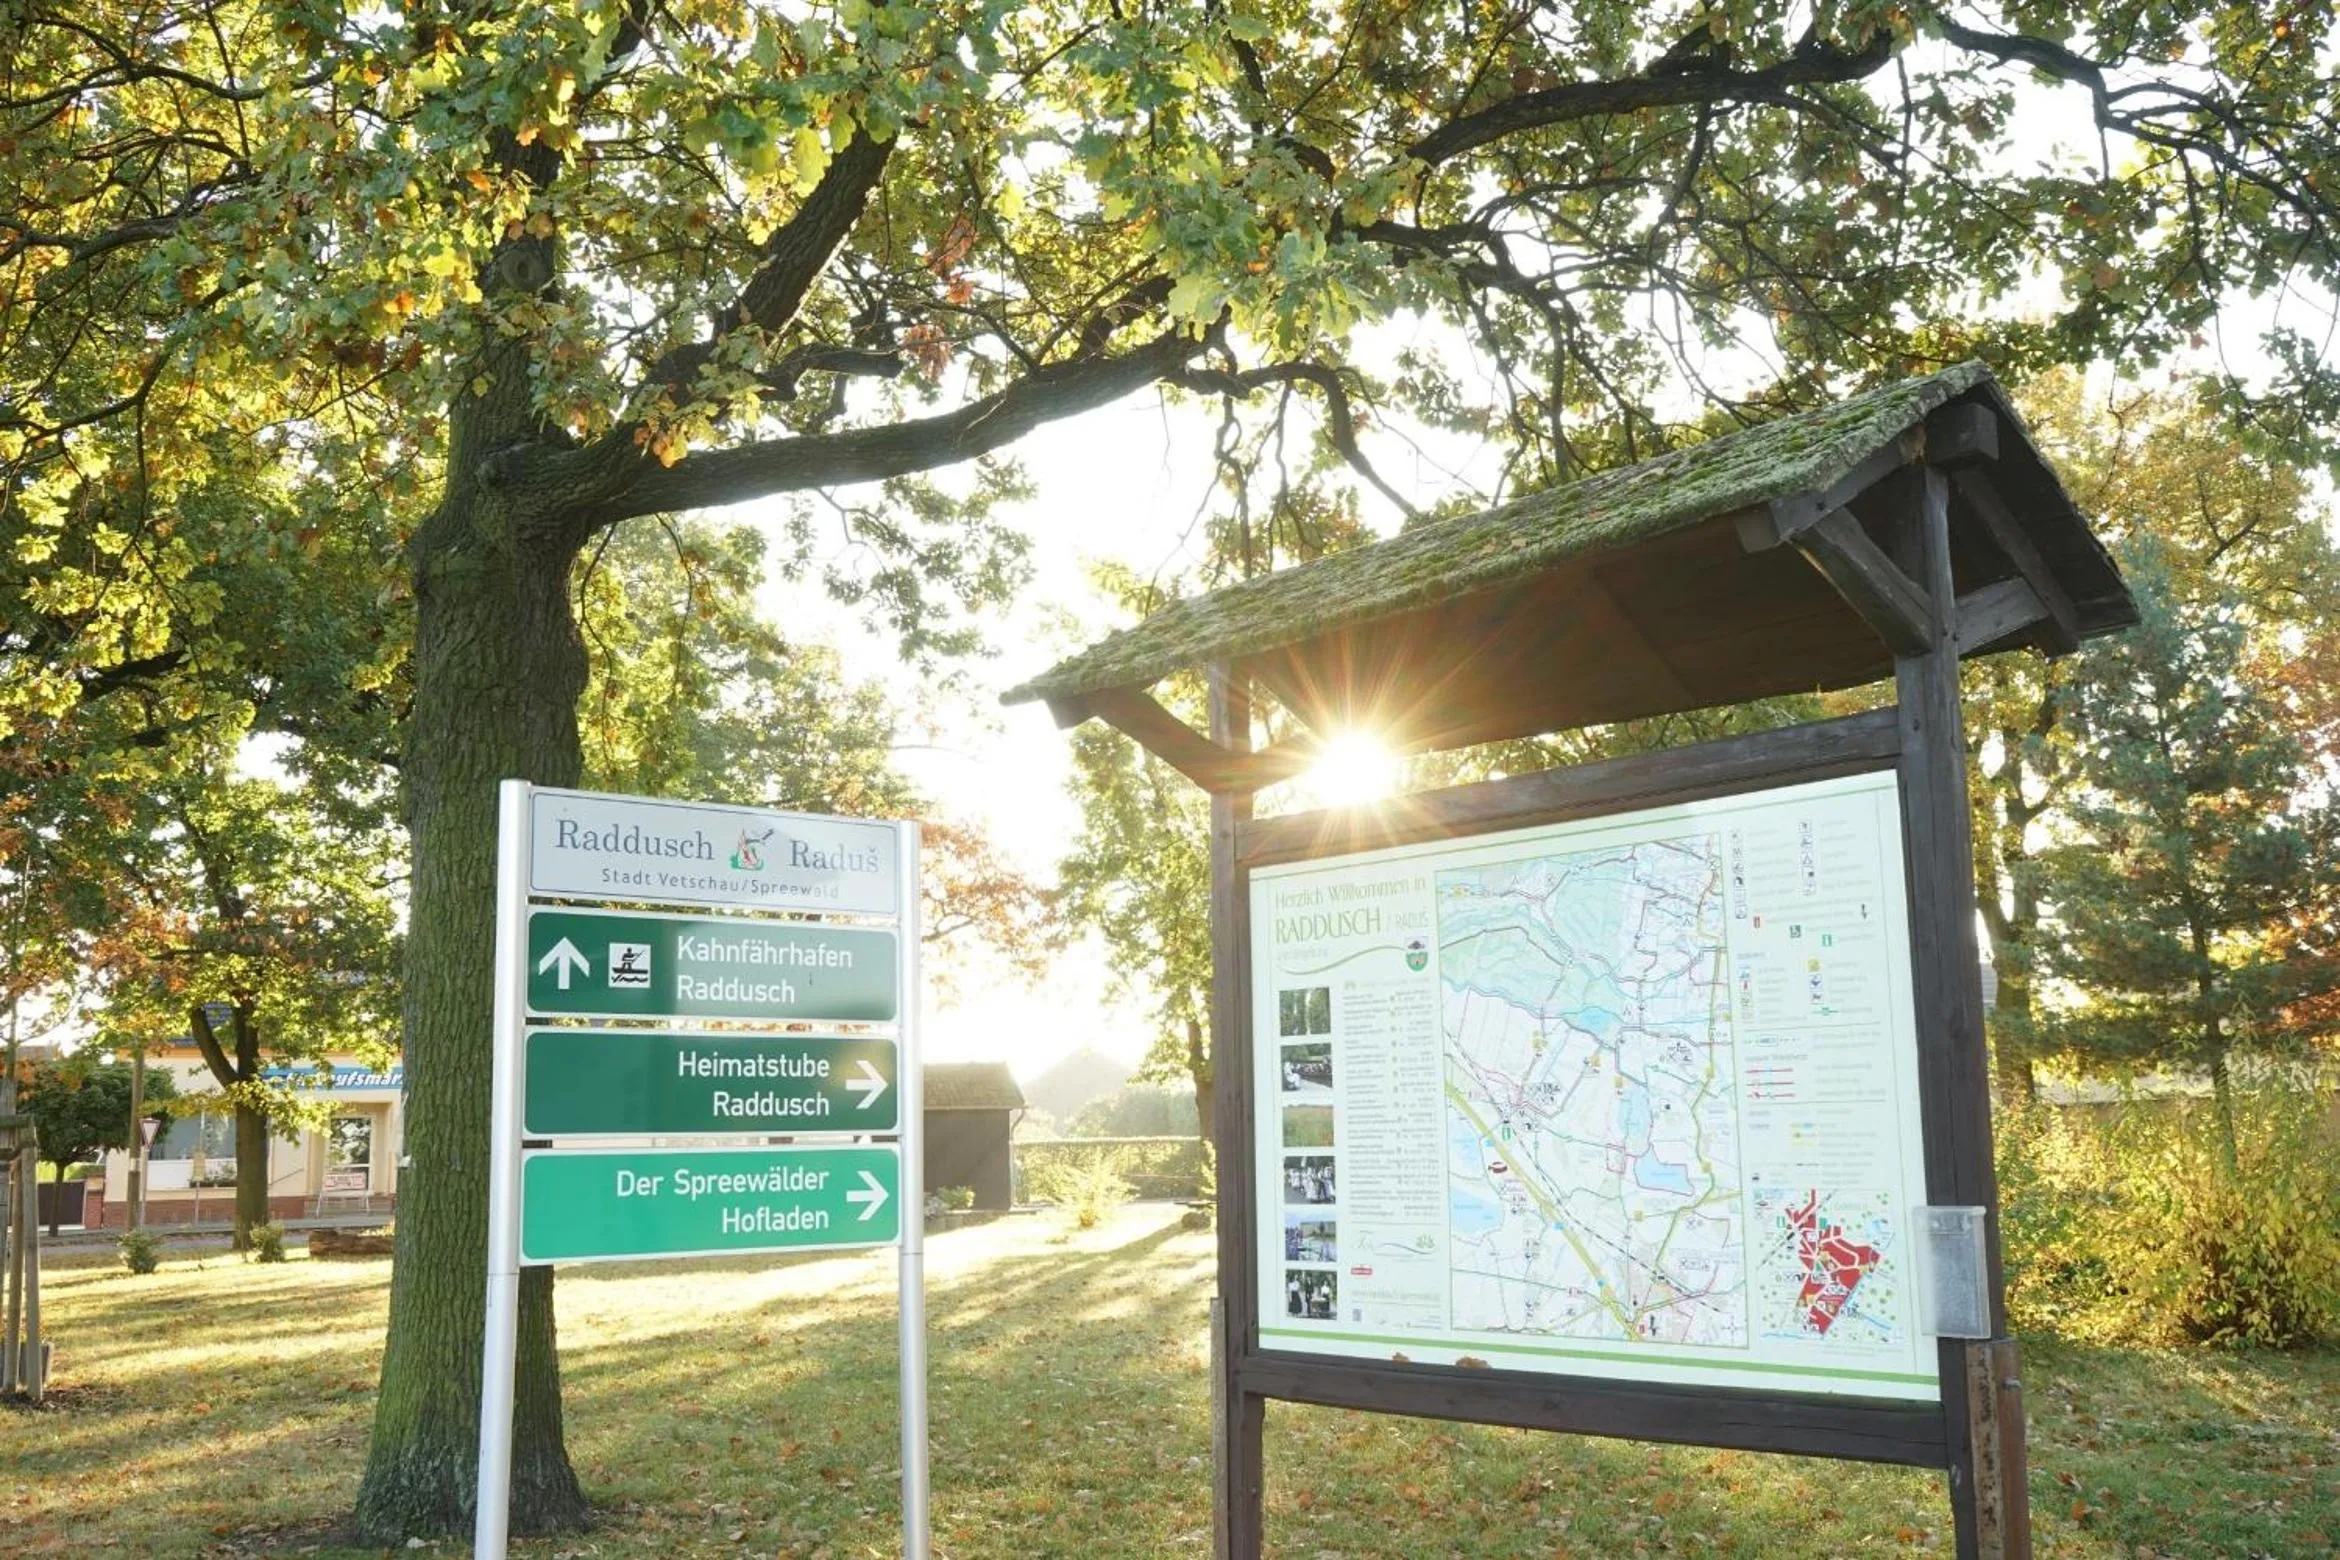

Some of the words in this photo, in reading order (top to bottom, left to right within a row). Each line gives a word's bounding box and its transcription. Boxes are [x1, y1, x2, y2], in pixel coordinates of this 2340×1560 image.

[555, 818, 715, 860] Raddusch
[788, 839, 879, 873] Raduš
[601, 868, 651, 886] Stadt
[1275, 908, 1381, 944] RADDUSCH
[677, 935, 853, 968] Kahnfährhafen
[677, 974, 795, 1004] Raddusch
[678, 1051, 830, 1078] Heimatstube
[712, 1091, 830, 1117] Raddusch
[616, 1170, 664, 1197] Der
[673, 1166, 830, 1201] Spreewälder
[722, 1205, 829, 1234] Hofladen
